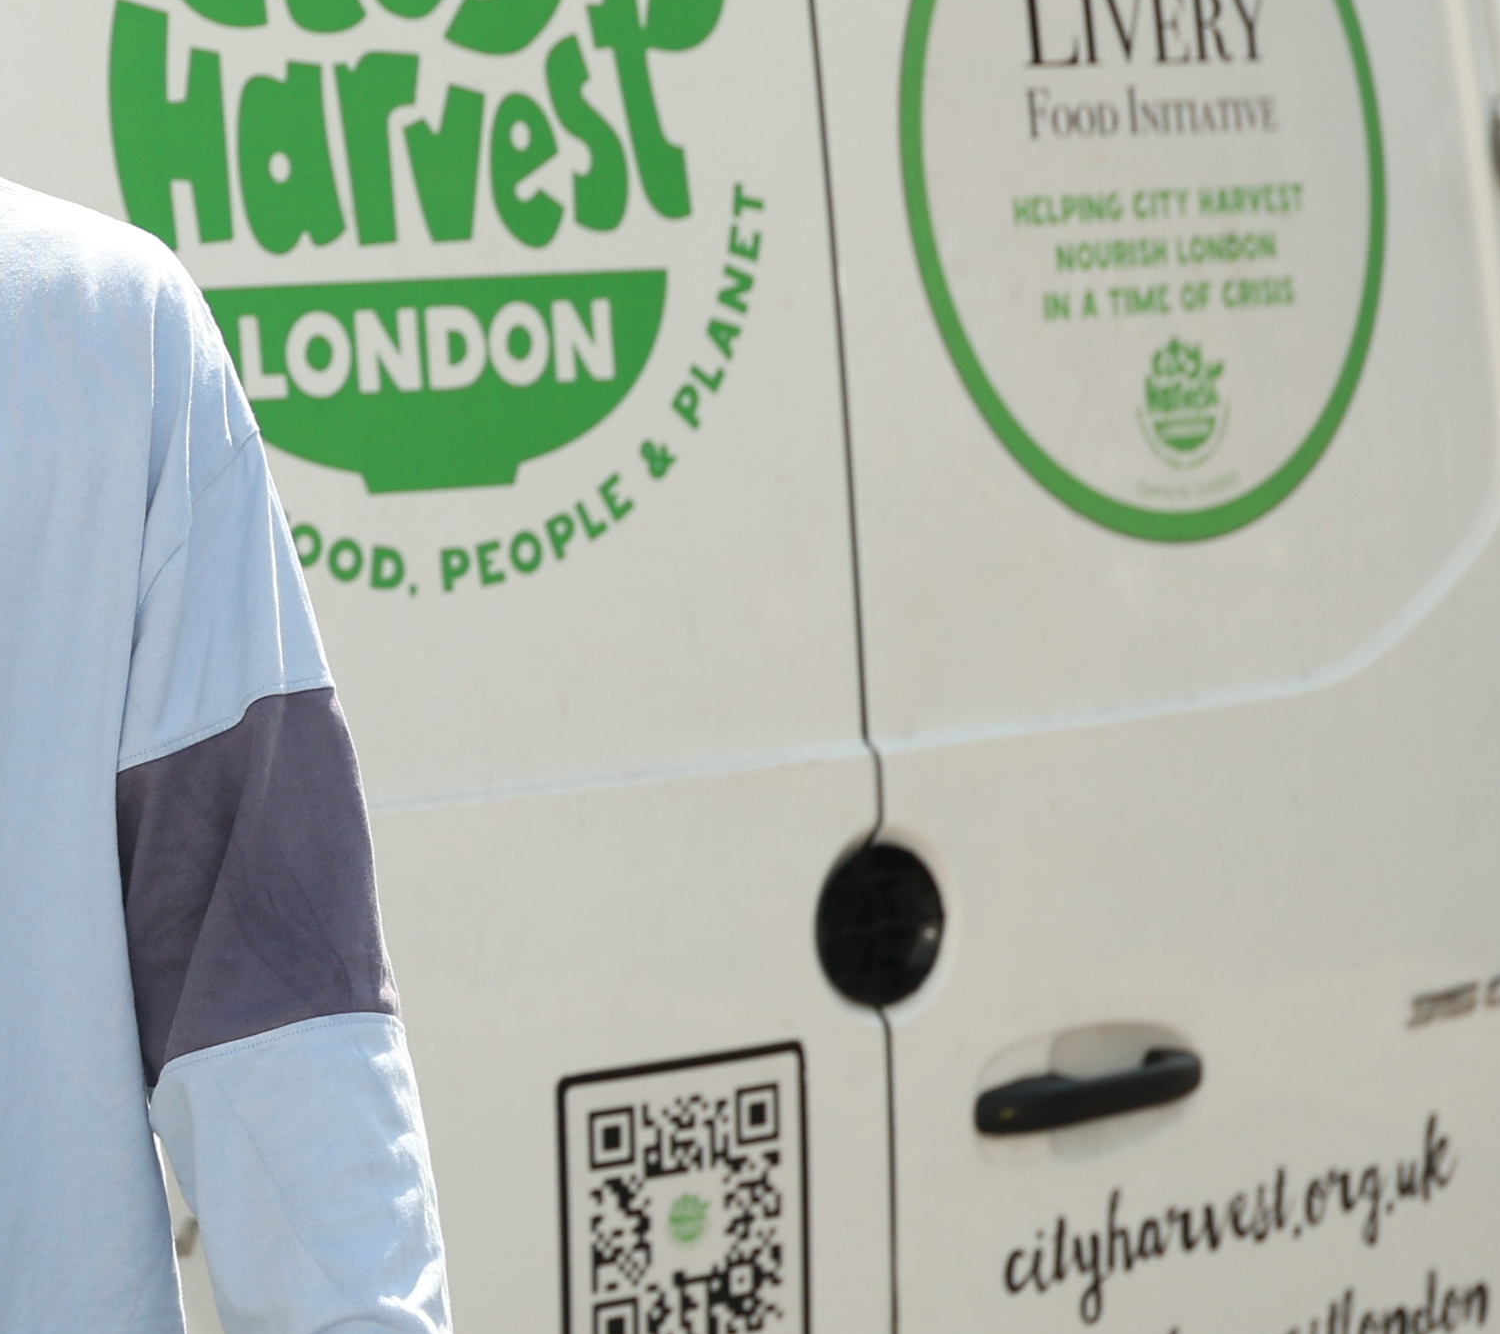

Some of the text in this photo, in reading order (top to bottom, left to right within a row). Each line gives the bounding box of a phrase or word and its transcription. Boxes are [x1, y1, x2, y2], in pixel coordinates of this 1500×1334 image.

[1012, 181, 1304, 227] HELPING CITY HARVEST
[1055, 230, 1278, 272] NOURISH LONDON
[1042, 273, 1296, 322] IN A TIME OF CRISIS
[237, 297, 618, 402] LONDON
[287, 181, 766, 598] OOD, PEOPLE & PLANET
[1004, 1112, 1457, 1326] cityharvest.org.uk
